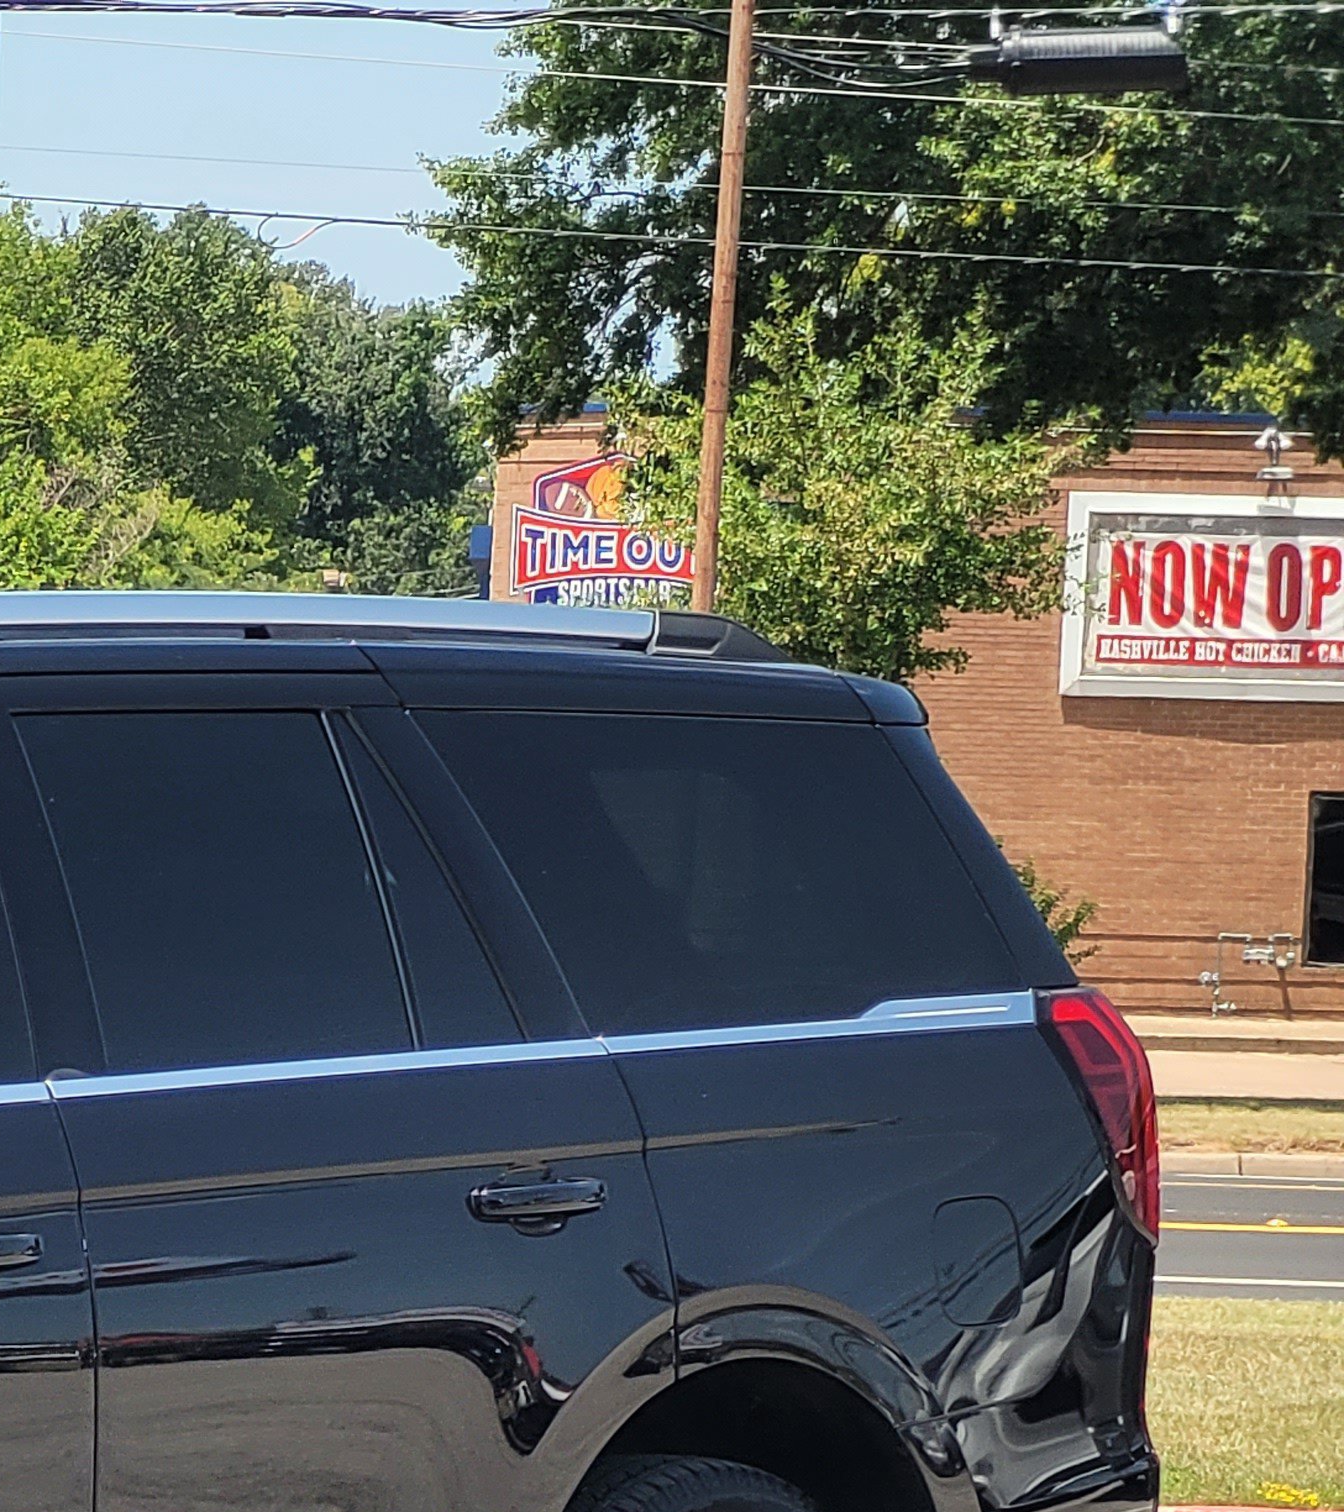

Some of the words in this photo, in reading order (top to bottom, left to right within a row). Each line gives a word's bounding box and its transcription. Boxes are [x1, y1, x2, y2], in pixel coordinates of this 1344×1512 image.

[521, 524, 618, 577] TIME
[622, 530, 695, 576] OU
[1108, 539, 1250, 629] NOW
[1099, 638, 1190, 661] NASHVILLE
[1195, 641, 1226, 662] HOT
[1231, 643, 1301, 663] CHICKEN
